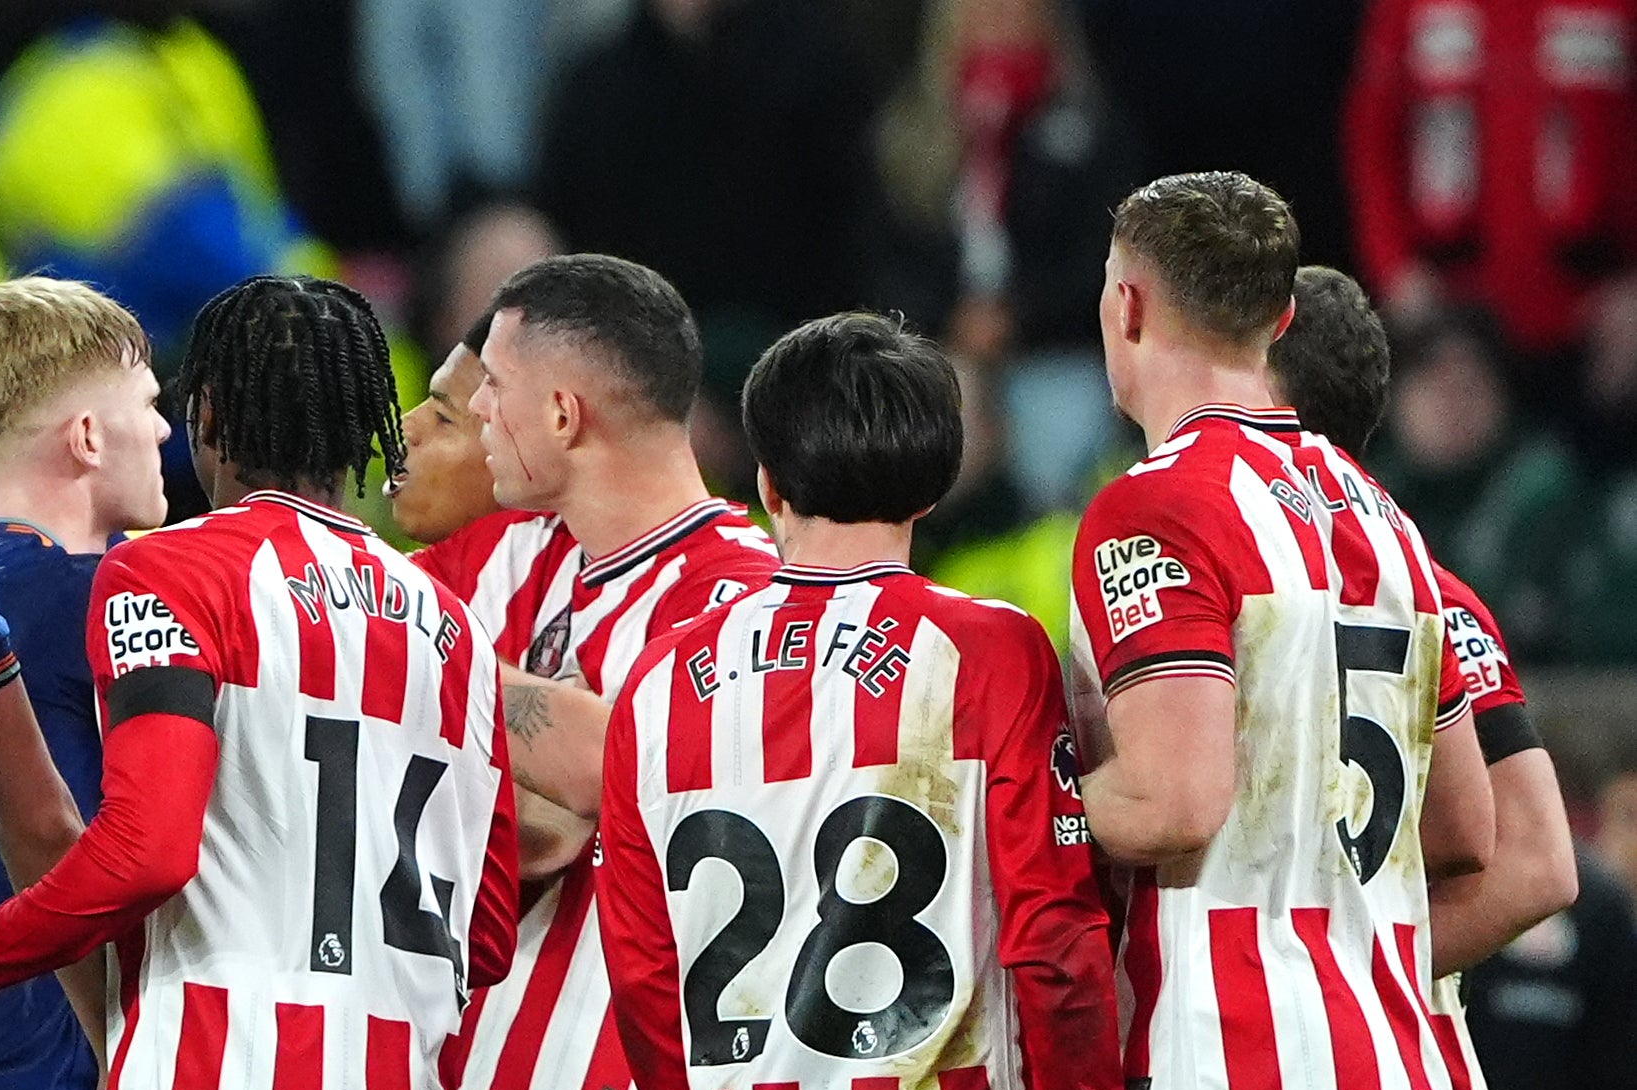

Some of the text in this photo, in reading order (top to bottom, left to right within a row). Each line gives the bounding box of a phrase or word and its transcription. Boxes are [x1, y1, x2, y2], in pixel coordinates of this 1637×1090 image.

[1097, 538, 1155, 576] Live
[1103, 561, 1185, 607] Score
[109, 595, 171, 627] Live
[287, 562, 461, 664] MUNDLE
[1109, 593, 1156, 638] Bet
[111, 627, 200, 660] Score
[686, 617, 912, 701] E. LE FÉE
[1335, 621, 1413, 887] 5
[1053, 815, 1079, 832] No
[304, 714, 468, 1016] 14
[665, 794, 956, 1067] 28
